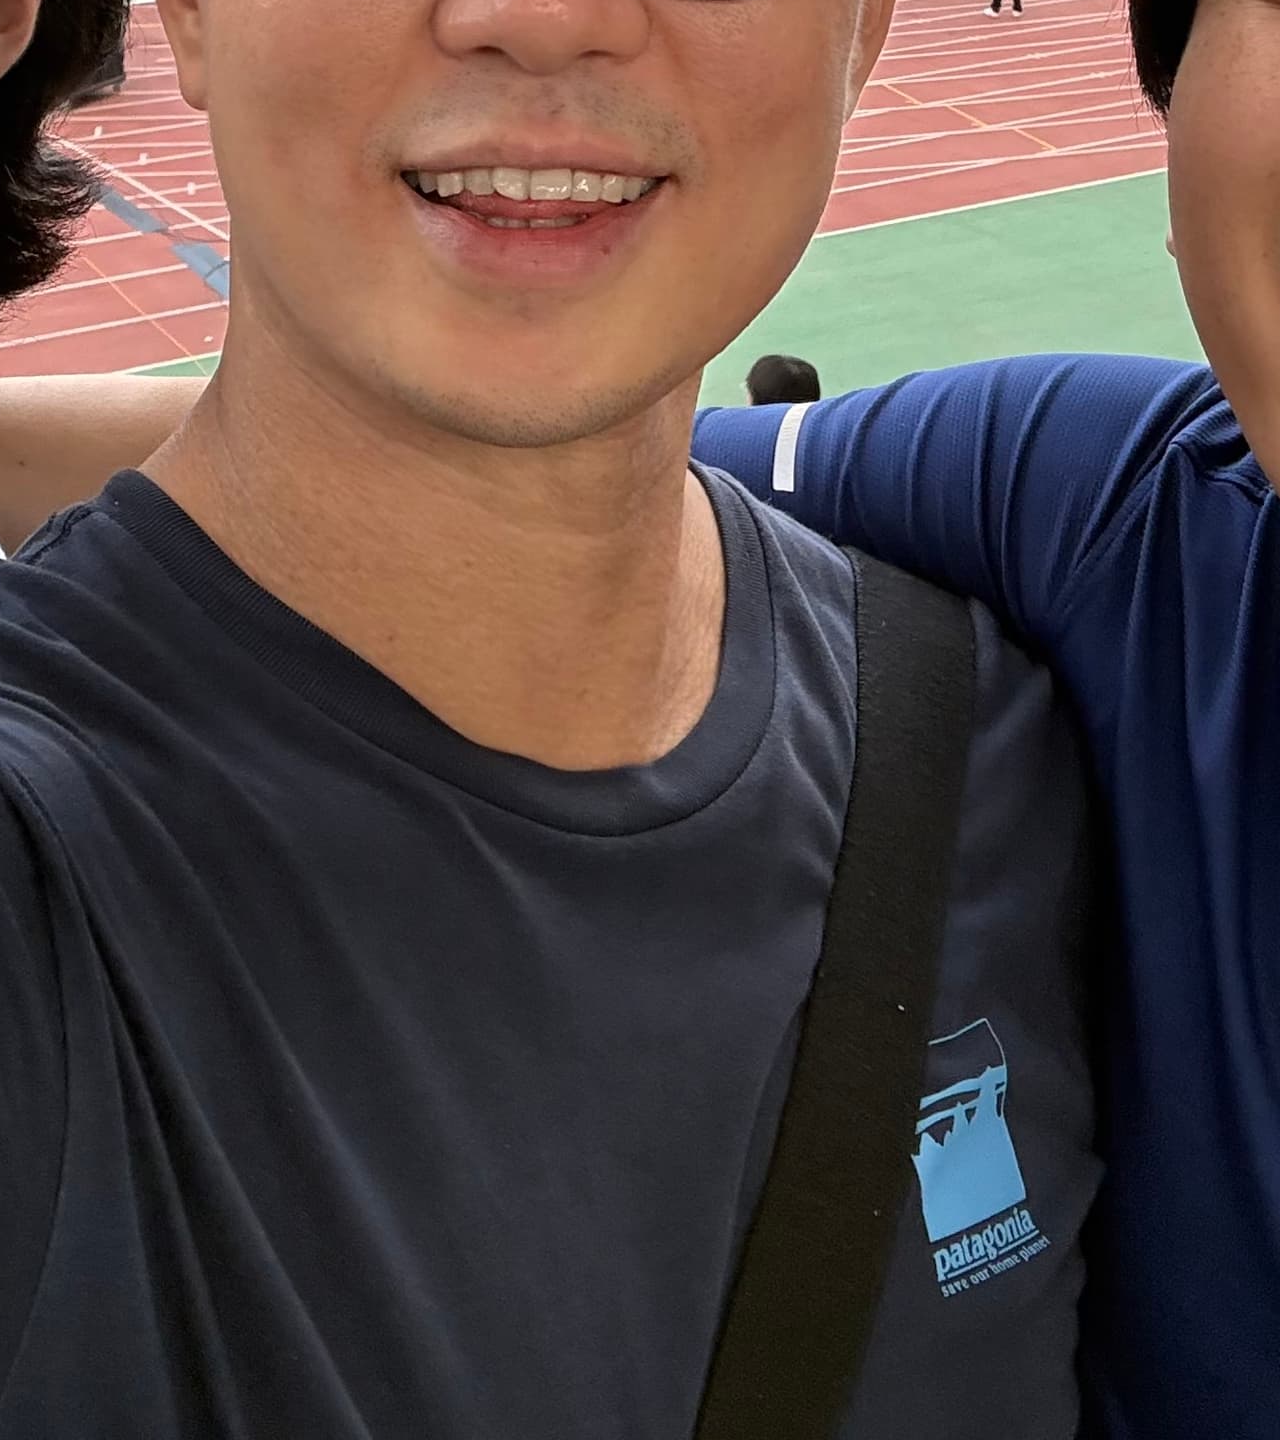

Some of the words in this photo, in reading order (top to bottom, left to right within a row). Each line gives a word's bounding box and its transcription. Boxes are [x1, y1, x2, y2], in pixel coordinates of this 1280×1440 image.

[933, 1207, 1036, 1282] patagonia
[941, 1276, 970, 1298] save
[970, 1267, 991, 1285] our
[991, 1253, 1021, 1275] home
[1020, 1234, 1051, 1262] planet
